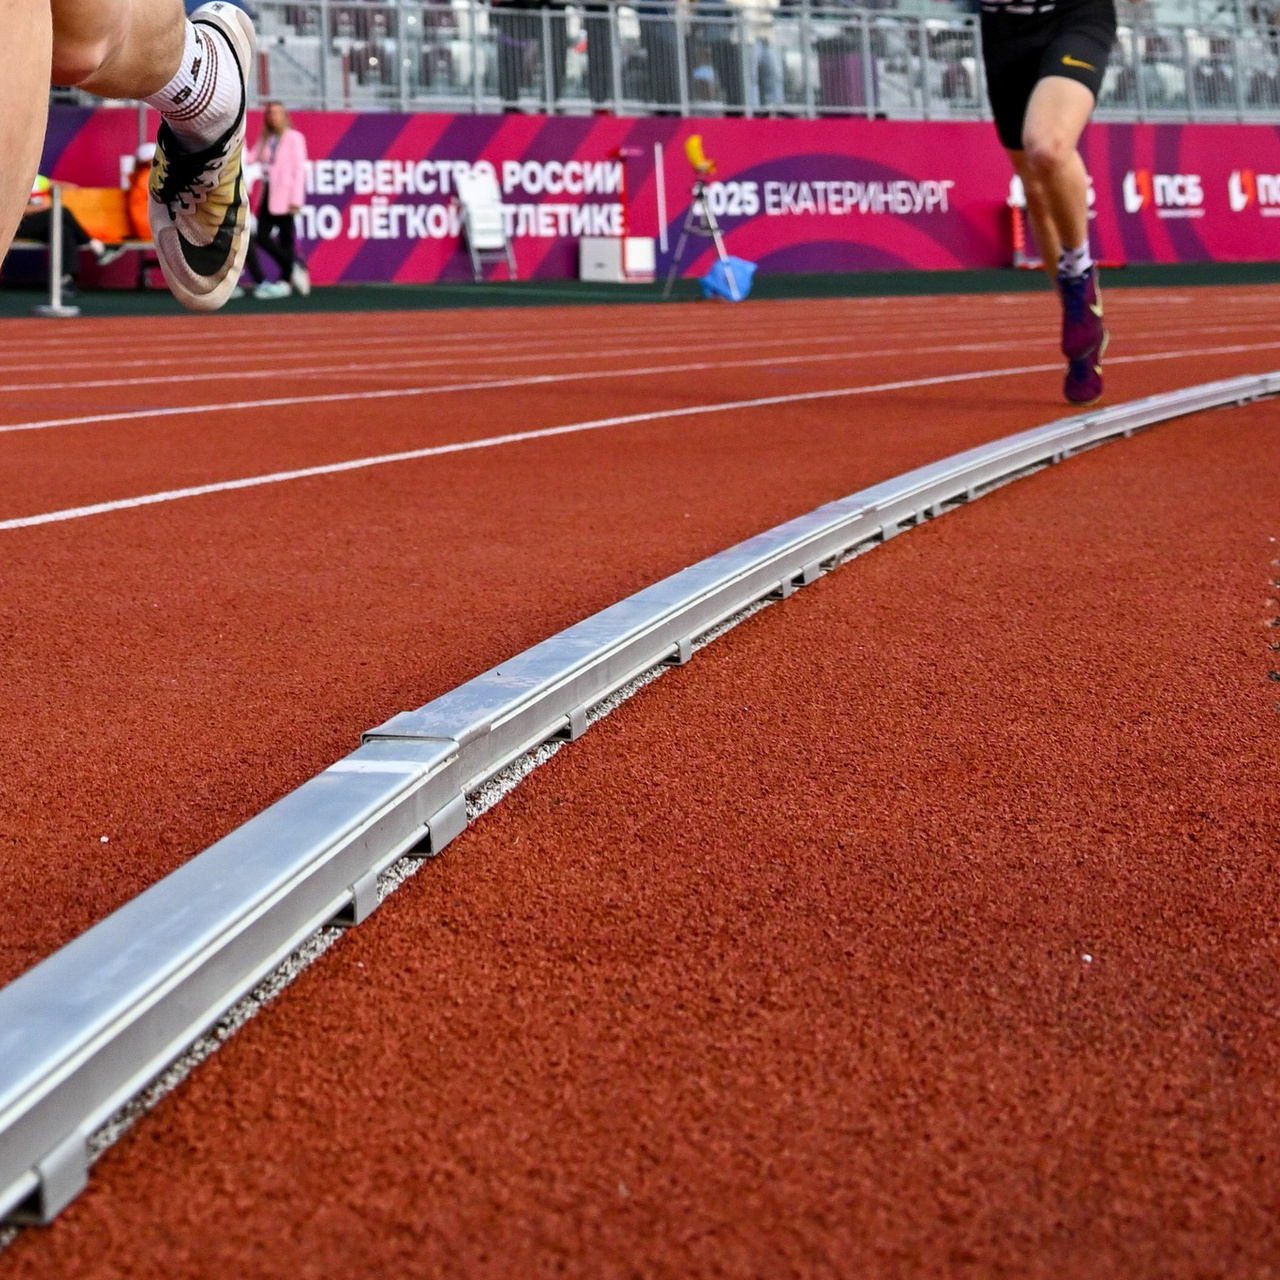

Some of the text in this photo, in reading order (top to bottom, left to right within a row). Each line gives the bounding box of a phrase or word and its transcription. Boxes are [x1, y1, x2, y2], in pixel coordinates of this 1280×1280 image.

[502, 160, 624, 195] РОССИИ
[1153, 173, 1205, 207] ПСБ
[763, 180, 955, 216] ЕКАТЕРИНБУРГ
[499, 203, 625, 238] ТЛЕТИКЕ
